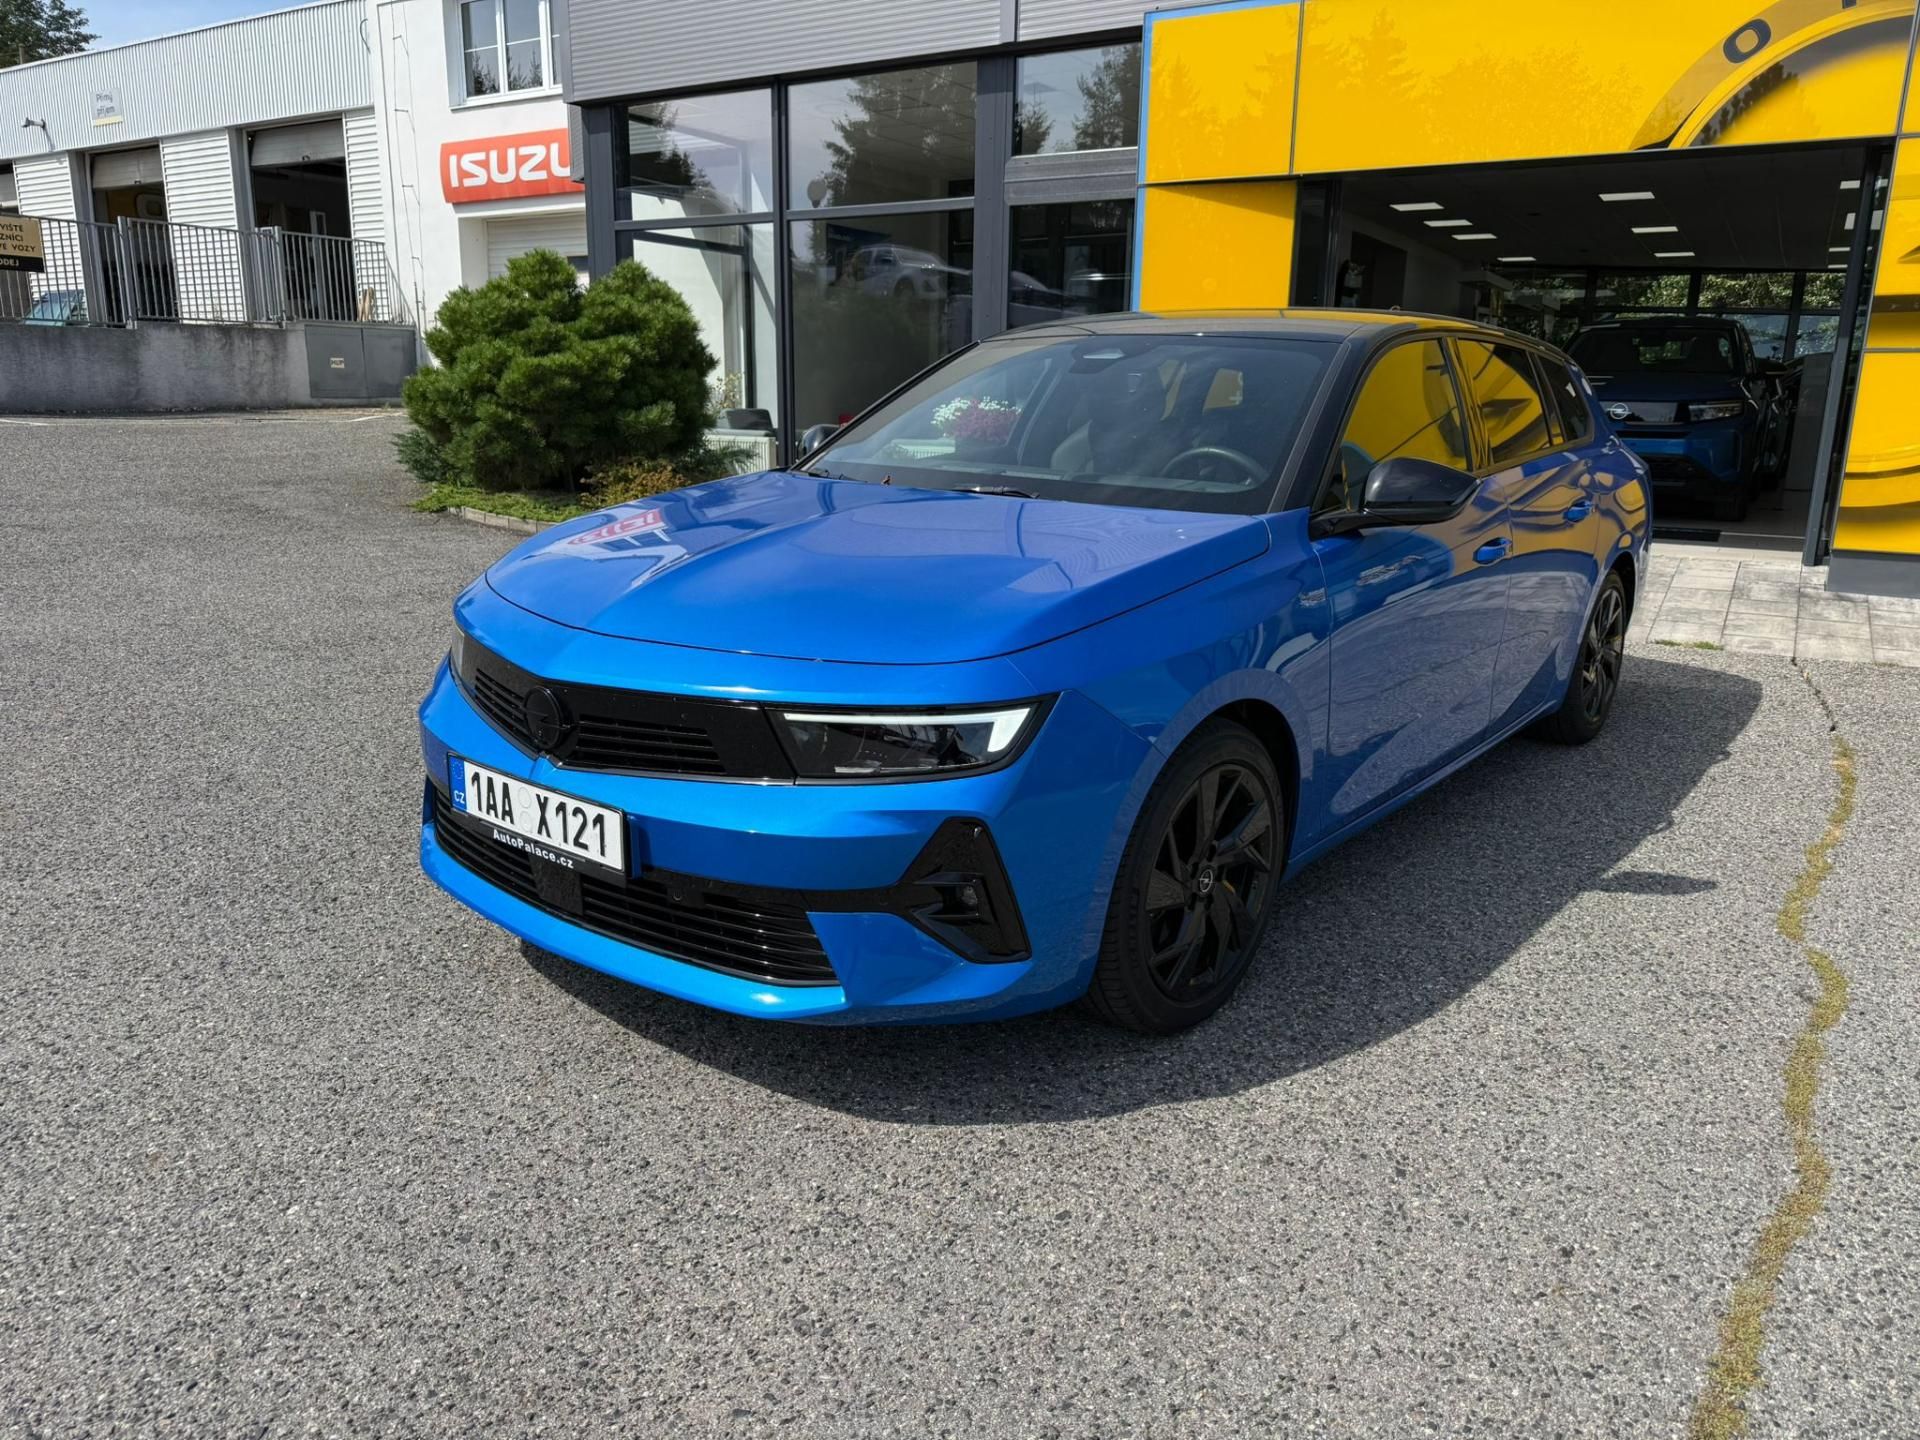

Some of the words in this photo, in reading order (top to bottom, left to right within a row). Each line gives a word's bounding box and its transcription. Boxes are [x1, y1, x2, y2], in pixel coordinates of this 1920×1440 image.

[450, 143, 571, 188] ISUZU
[11, 243, 36, 252] VOZY
[453, 789, 465, 804] CZ
[471, 771, 515, 825] 1AA
[536, 793, 606, 857] X121
[493, 829, 574, 869] AutoPalace.cz
